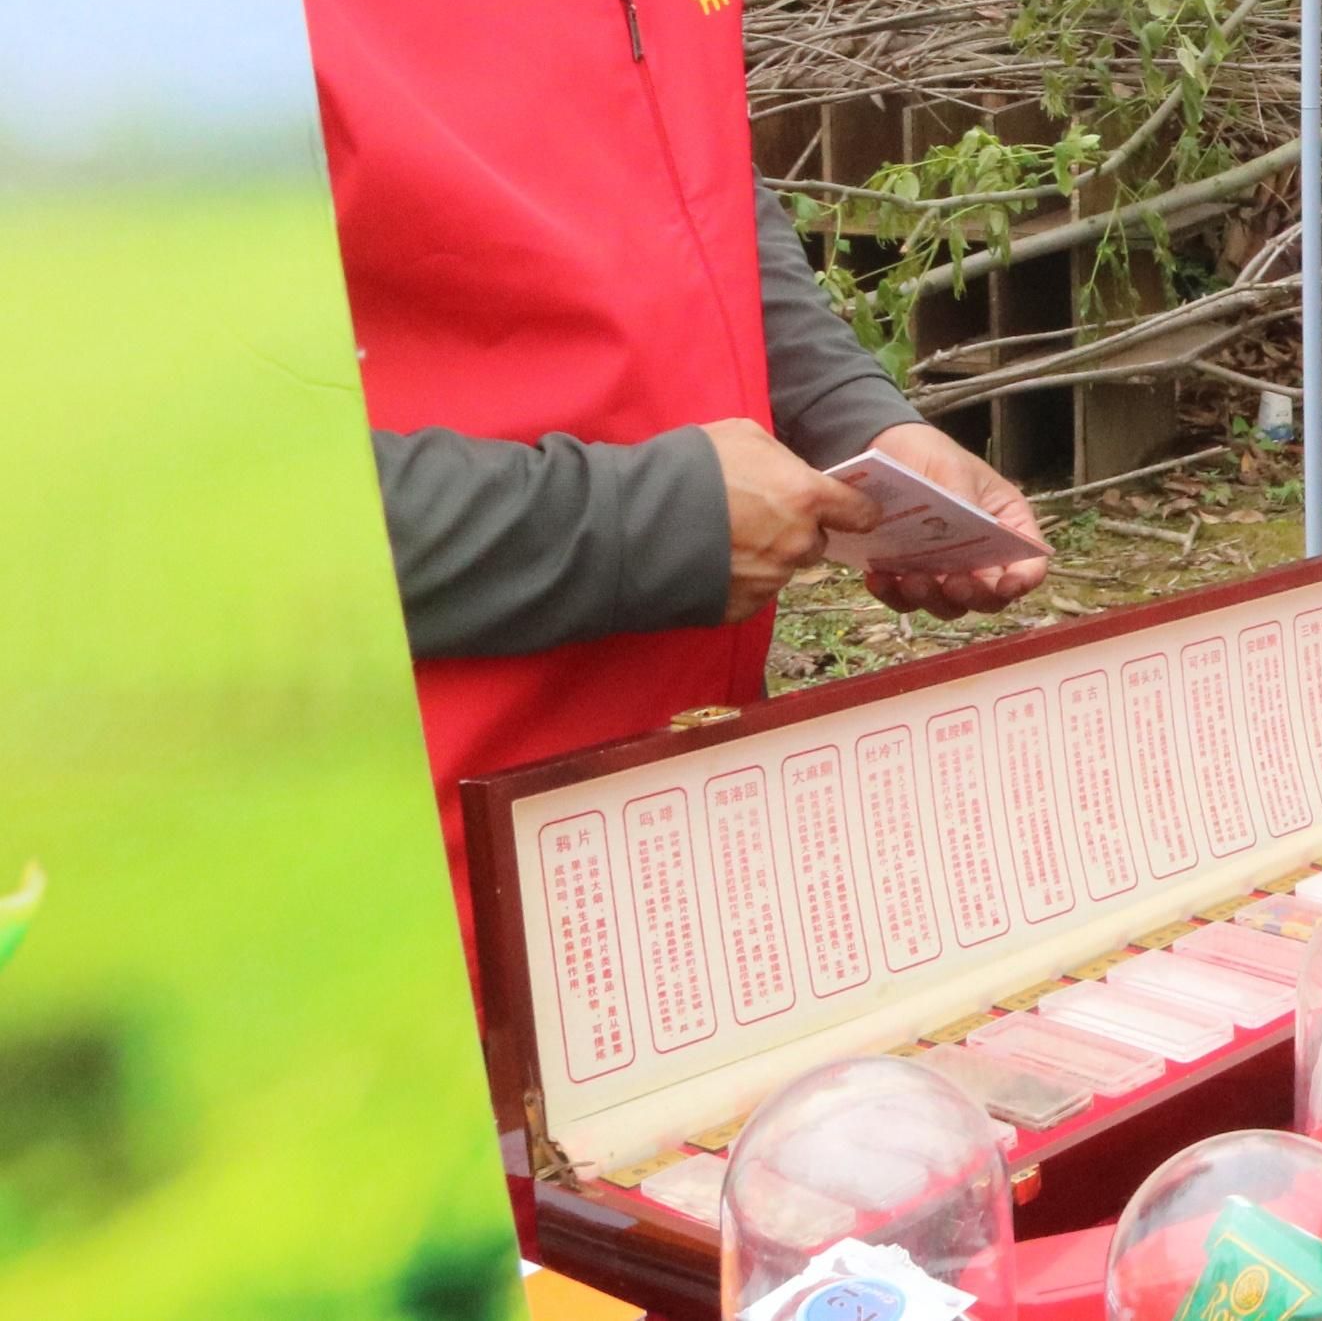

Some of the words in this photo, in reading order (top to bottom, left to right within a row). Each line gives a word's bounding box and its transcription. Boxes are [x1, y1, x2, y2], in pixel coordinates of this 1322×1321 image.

[1188, 649, 1222, 669] 可卡因
[865, 739, 905, 763] 杜冷丁
[714, 781, 759, 807] 海洛因
[639, 805, 674, 828] 吗啡
[555, 829, 592, 853] 鸦片
